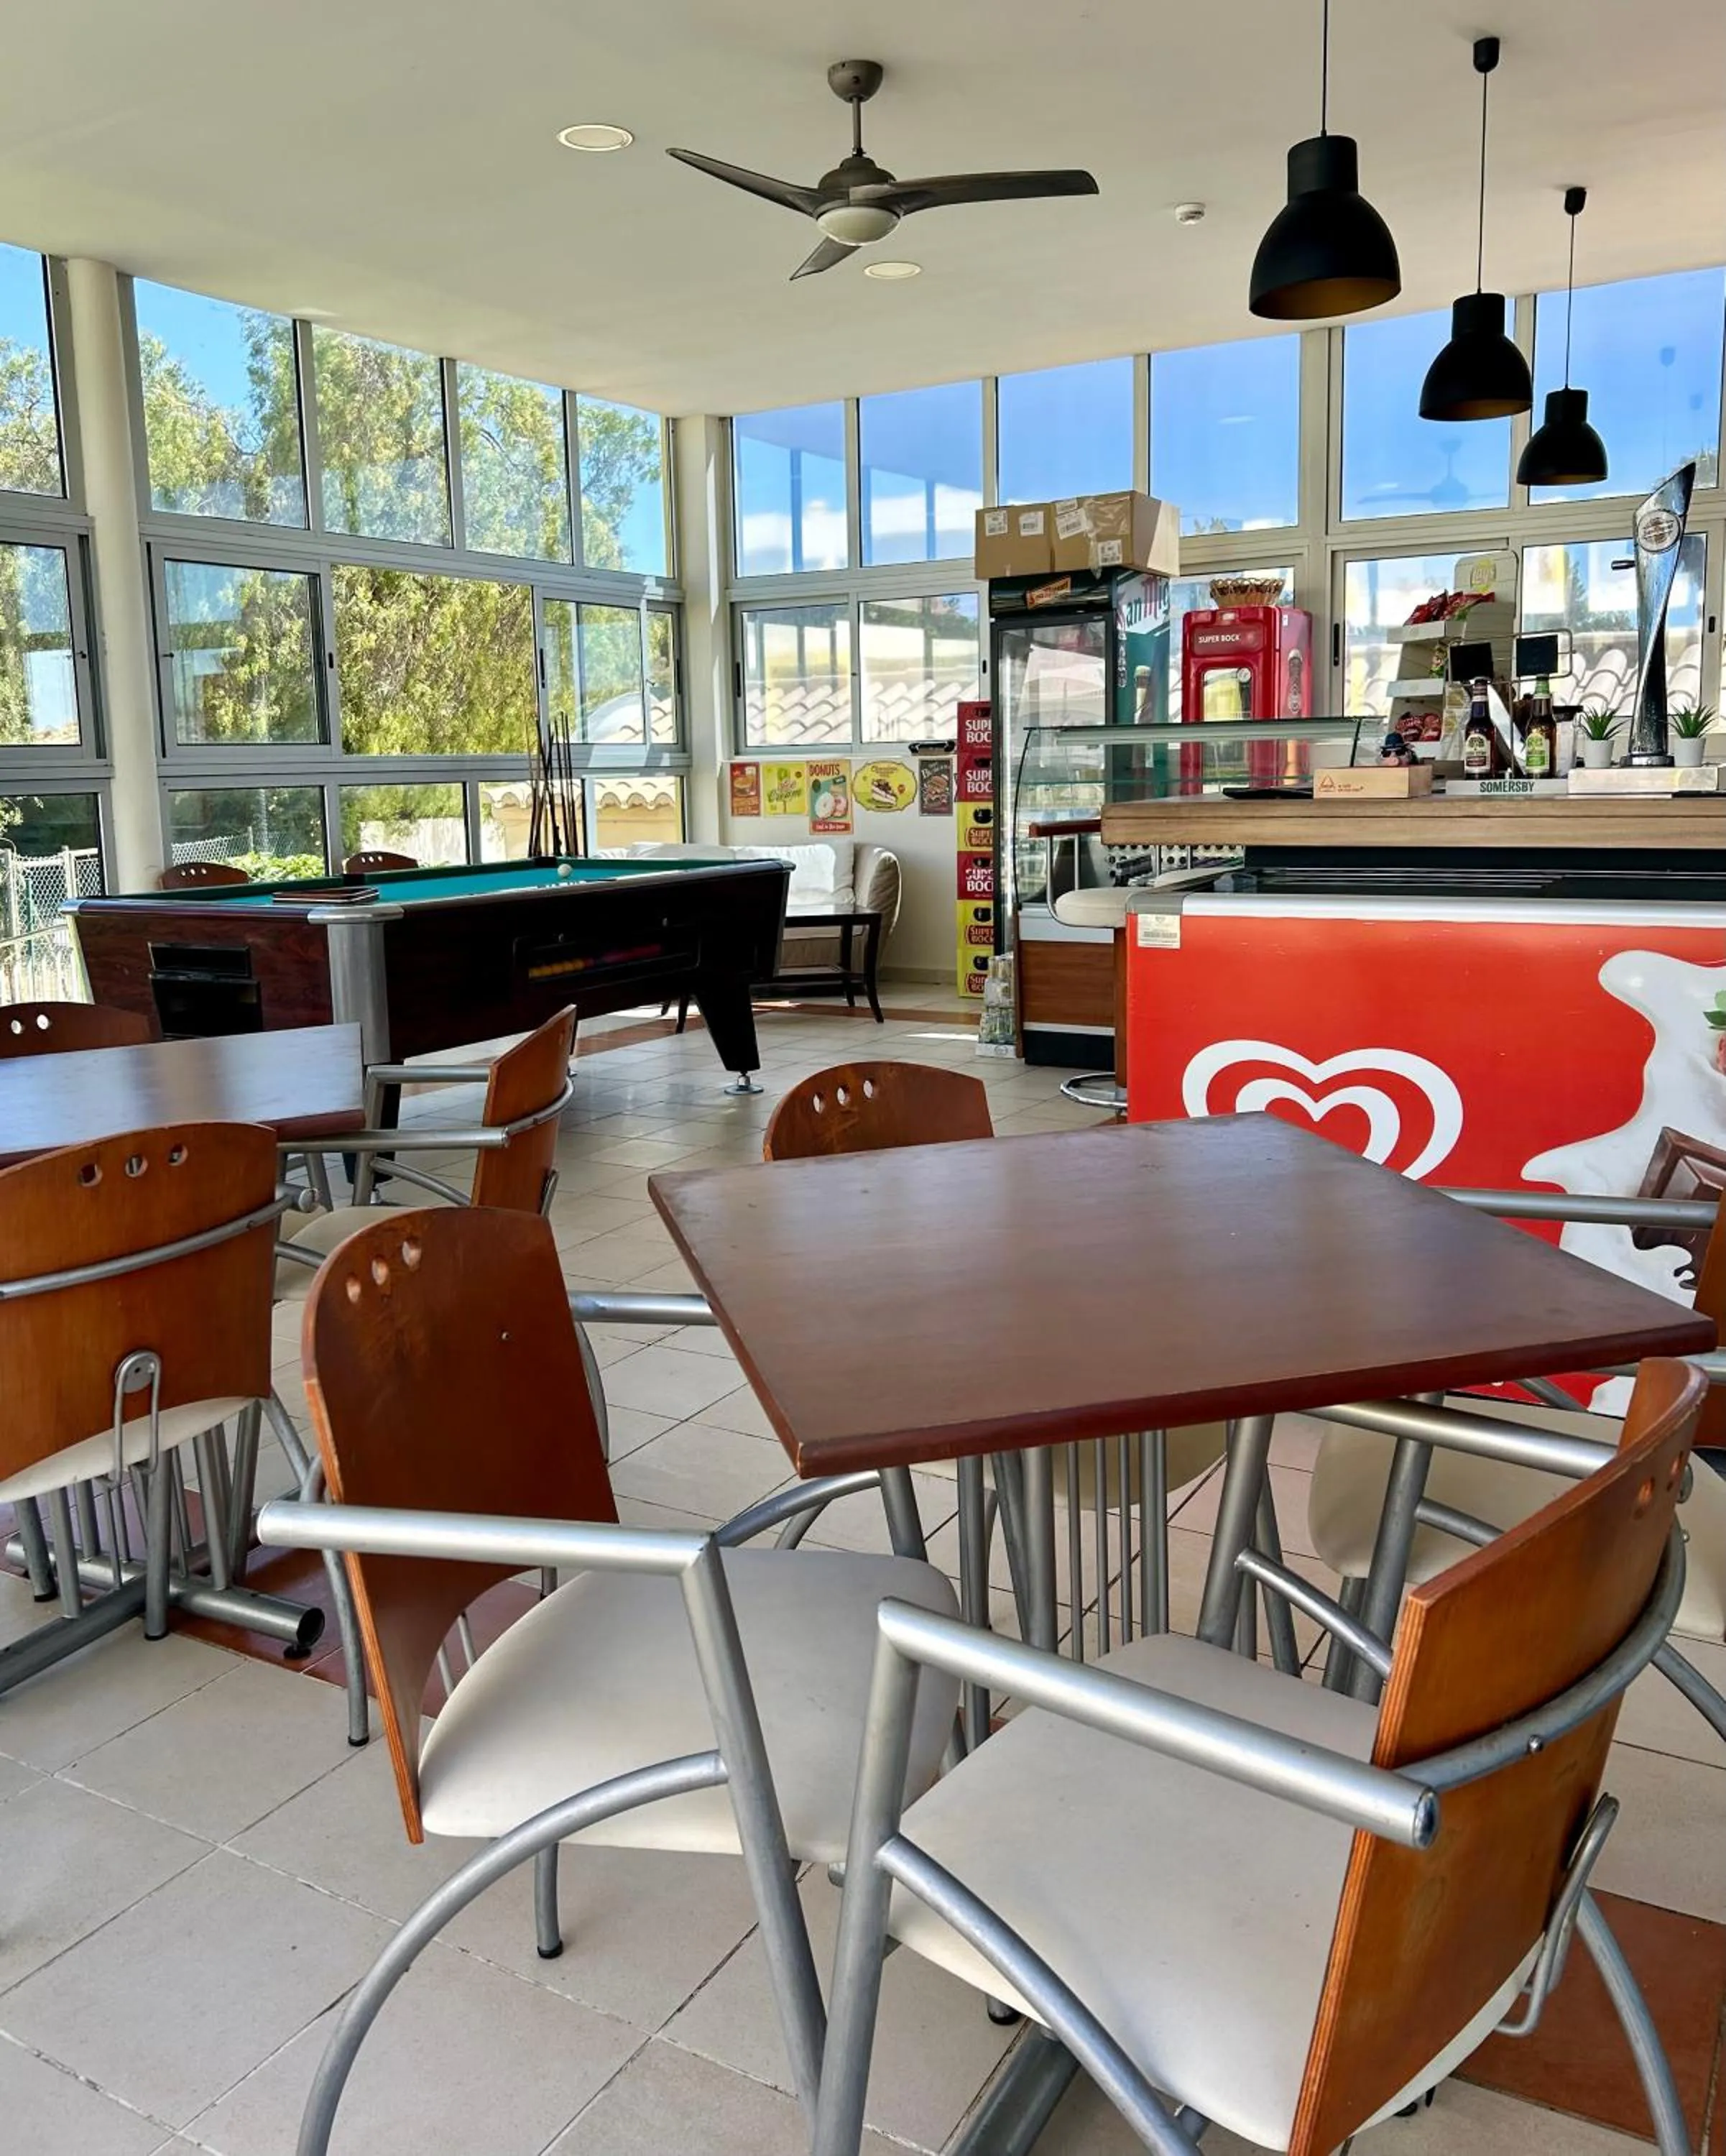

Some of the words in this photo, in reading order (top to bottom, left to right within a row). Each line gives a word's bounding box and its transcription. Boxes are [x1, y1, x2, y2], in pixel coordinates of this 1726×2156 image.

[1141, 574, 1170, 619] Mig
[965, 719, 992, 731] SUP
[966, 732, 992, 742] BOC
[808, 763, 841, 777] DONUTS
[966, 770, 992, 781] SUP
[966, 781, 993, 793] BOC
[1480, 781, 1535, 793] SOMERSBY
[965, 868, 994, 880] SUPE
[966, 880, 994, 892] BOC
